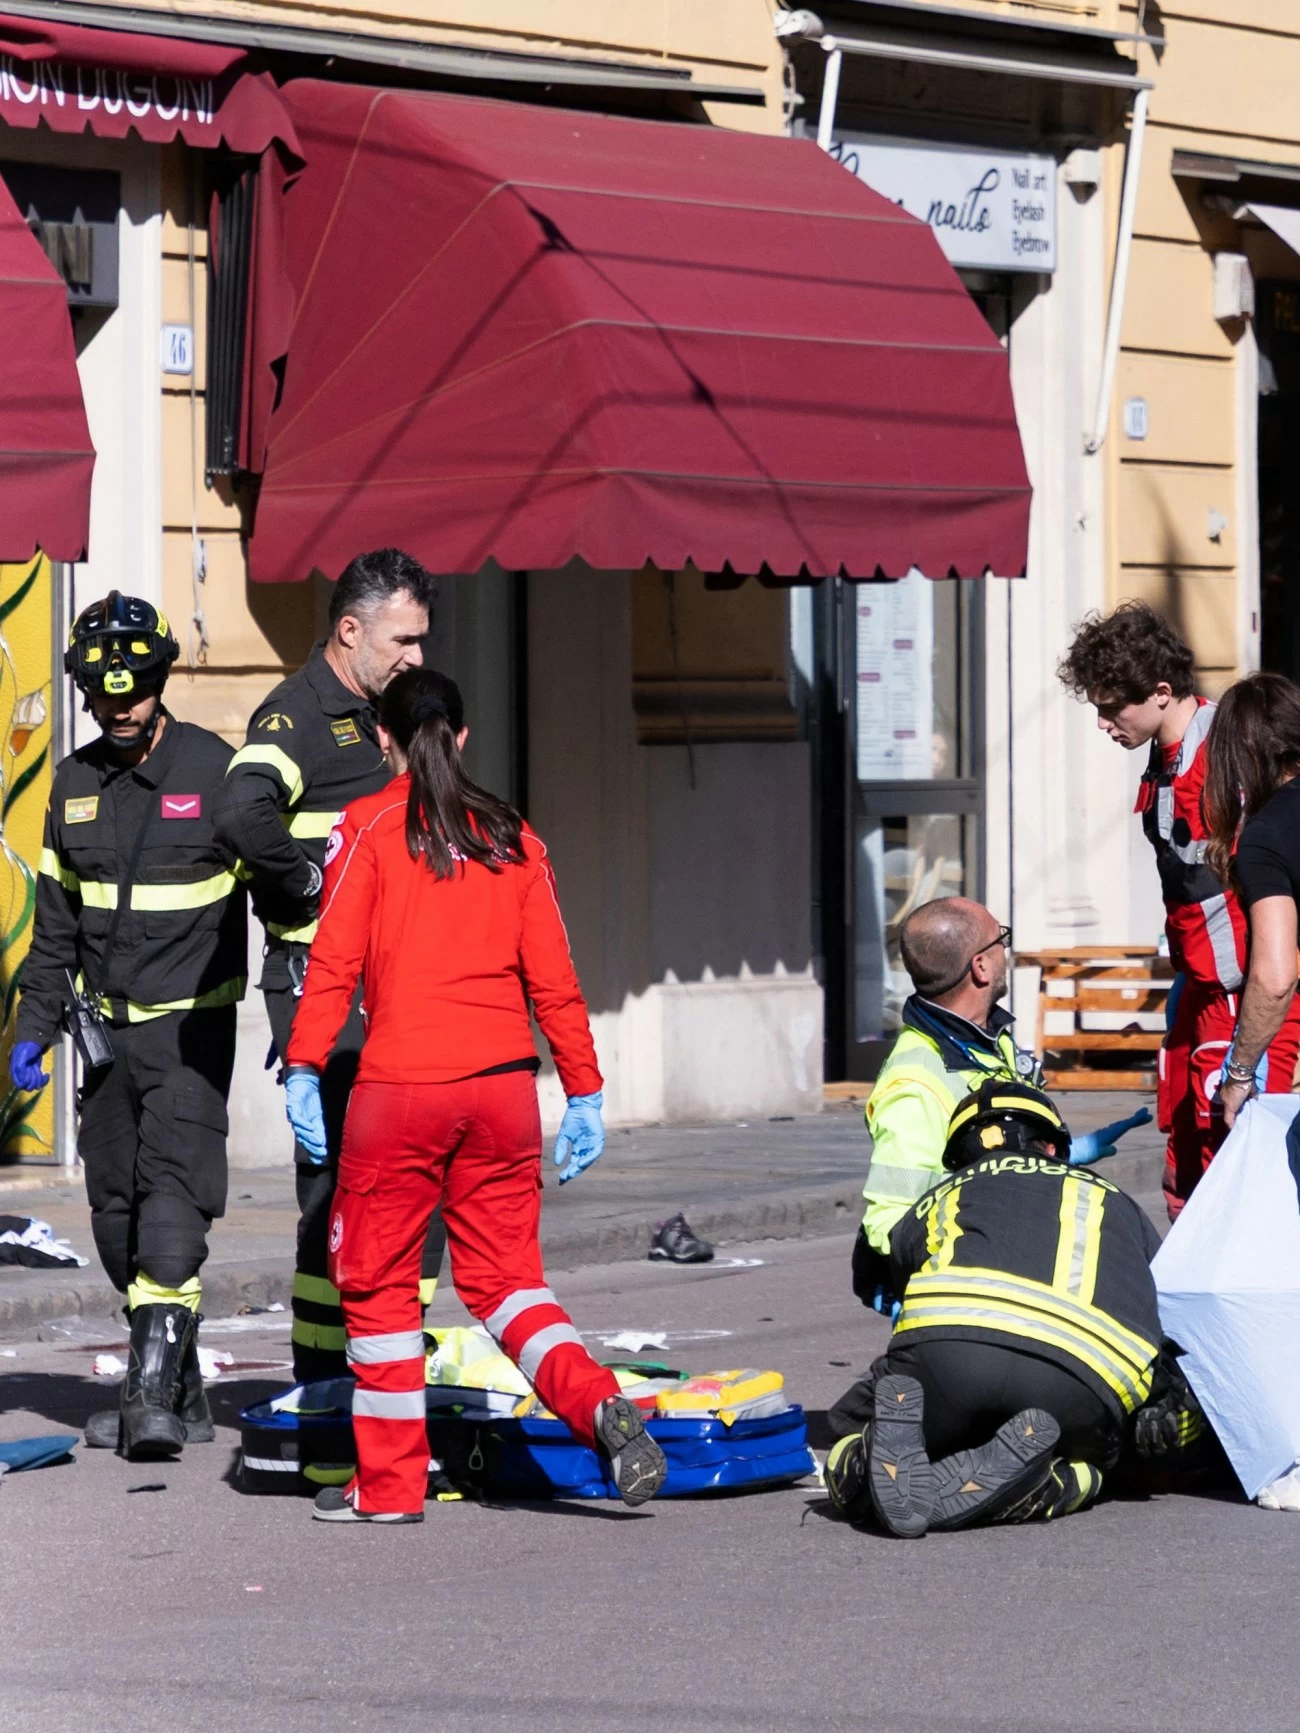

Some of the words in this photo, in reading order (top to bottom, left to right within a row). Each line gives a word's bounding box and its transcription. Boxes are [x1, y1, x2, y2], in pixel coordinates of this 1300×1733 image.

[78, 67, 213, 124] DUGONI
[927, 168, 1000, 233] nails
[170, 333, 187, 365] 46
[915, 1176, 974, 1219] DEL
